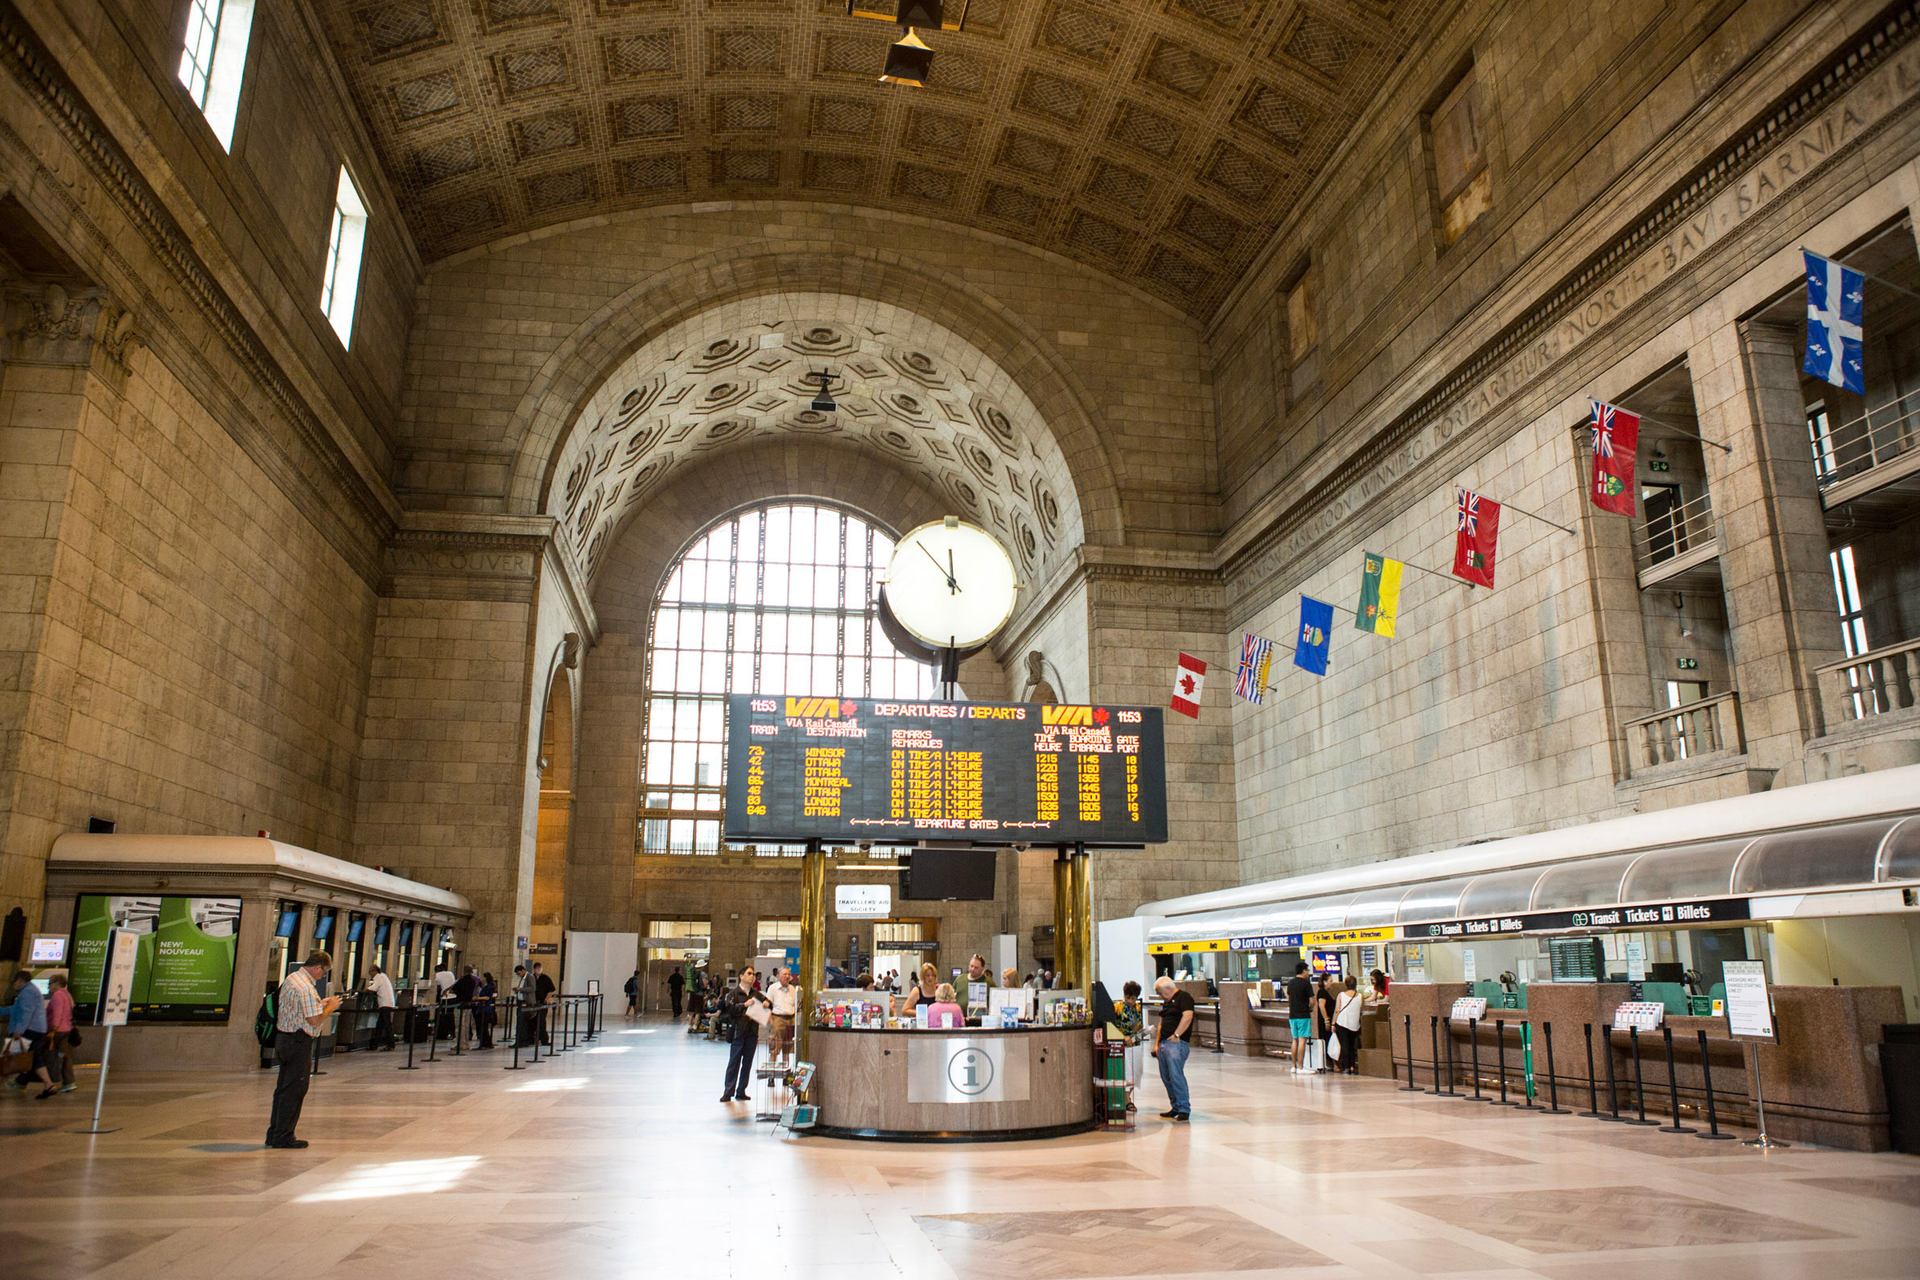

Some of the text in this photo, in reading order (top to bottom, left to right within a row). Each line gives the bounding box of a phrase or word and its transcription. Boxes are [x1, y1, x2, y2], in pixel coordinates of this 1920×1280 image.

[1736, 106, 1865, 217] SARNIA
[1567, 212, 1710, 345] NORTH-BAY
[1433, 341, 1554, 448] PORT-ARTHUR
[1361, 440, 1424, 499] WINNIPEG
[388, 550, 527, 572] VANCOUVER
[751, 700, 777, 712] 11:53
[785, 697, 840, 718] VIA
[874, 704, 957, 718] DEPARTURES
[968, 706, 1026, 720] DEPARTS
[1042, 705, 1093, 725] VIA
[1117, 711, 1142, 723] 11:53
[750, 725, 779, 735] TRAIN
[786, 718, 858, 729] VIA Rail Canada
[1042, 726, 1110, 736] VIA Rail Canada
[806, 728, 867, 738] DESTINATION
[891, 729, 932, 739] REMARKS
[1034, 733, 1139, 744] TIME BOARDING GATE
[891, 739, 943, 749] REMARQUES
[1034, 742, 1139, 753] HEURE EMBARQUE PORT
[805, 748, 846, 758] WINDSOR
[891, 750, 905, 759] ON
[944, 752, 983, 761] L'HEURE
[1036, 754, 1058, 763] 1215
[1078, 754, 1100, 764] 1145
[748, 756, 762, 765] 42
[805, 758, 841, 767] OTTAWA
[891, 760, 905, 770] ON
[944, 761, 983, 770] L'HEURE
[1036, 764, 1059, 773] 1220
[1078, 764, 1100, 773] 1150
[805, 768, 841, 777] OTTAWA
[891, 770, 905, 779] ON
[944, 771, 983, 780] L'HEURE
[1036, 772, 1059, 782] 1425
[1078, 774, 1100, 783] 1355
[1126, 774, 1139, 784] 17
[804, 777, 852, 787] MONTREAL
[891, 780, 905, 789] ON
[944, 780, 983, 790] L'HEURE
[1036, 782, 1059, 792] 1515
[1078, 783, 1100, 792] 1445
[804, 787, 841, 796] OTTAWA
[891, 789, 905, 798] ON
[944, 790, 983, 800] L'HEURE
[1037, 792, 1059, 802] 1530
[1079, 792, 1101, 802] 1500
[1127, 793, 1139, 802] 17
[804, 797, 841, 806] LONDON
[891, 799, 905, 808] ON
[944, 800, 983, 810] L'HEURE
[804, 806, 841, 816] OTTAWA
[891, 808, 905, 818] ON
[944, 810, 983, 819] L'HEURE
[1131, 812, 1140, 822] 3
[914, 818, 999, 830] DEPARTURE GATES
[1590, 911, 1620, 925] Transit
[1625, 908, 1659, 923] Tickets
[1677, 905, 1711, 920] Billets
[1441, 923, 1463, 935] Transit
[1465, 921, 1489, 933] Tickets
[1500, 919, 1523, 931] Billets
[1242, 939, 1262, 949] LOTTO
[1263, 937, 1289, 948] CENTRE
[159, 948, 205, 956] NOUVEAU!
